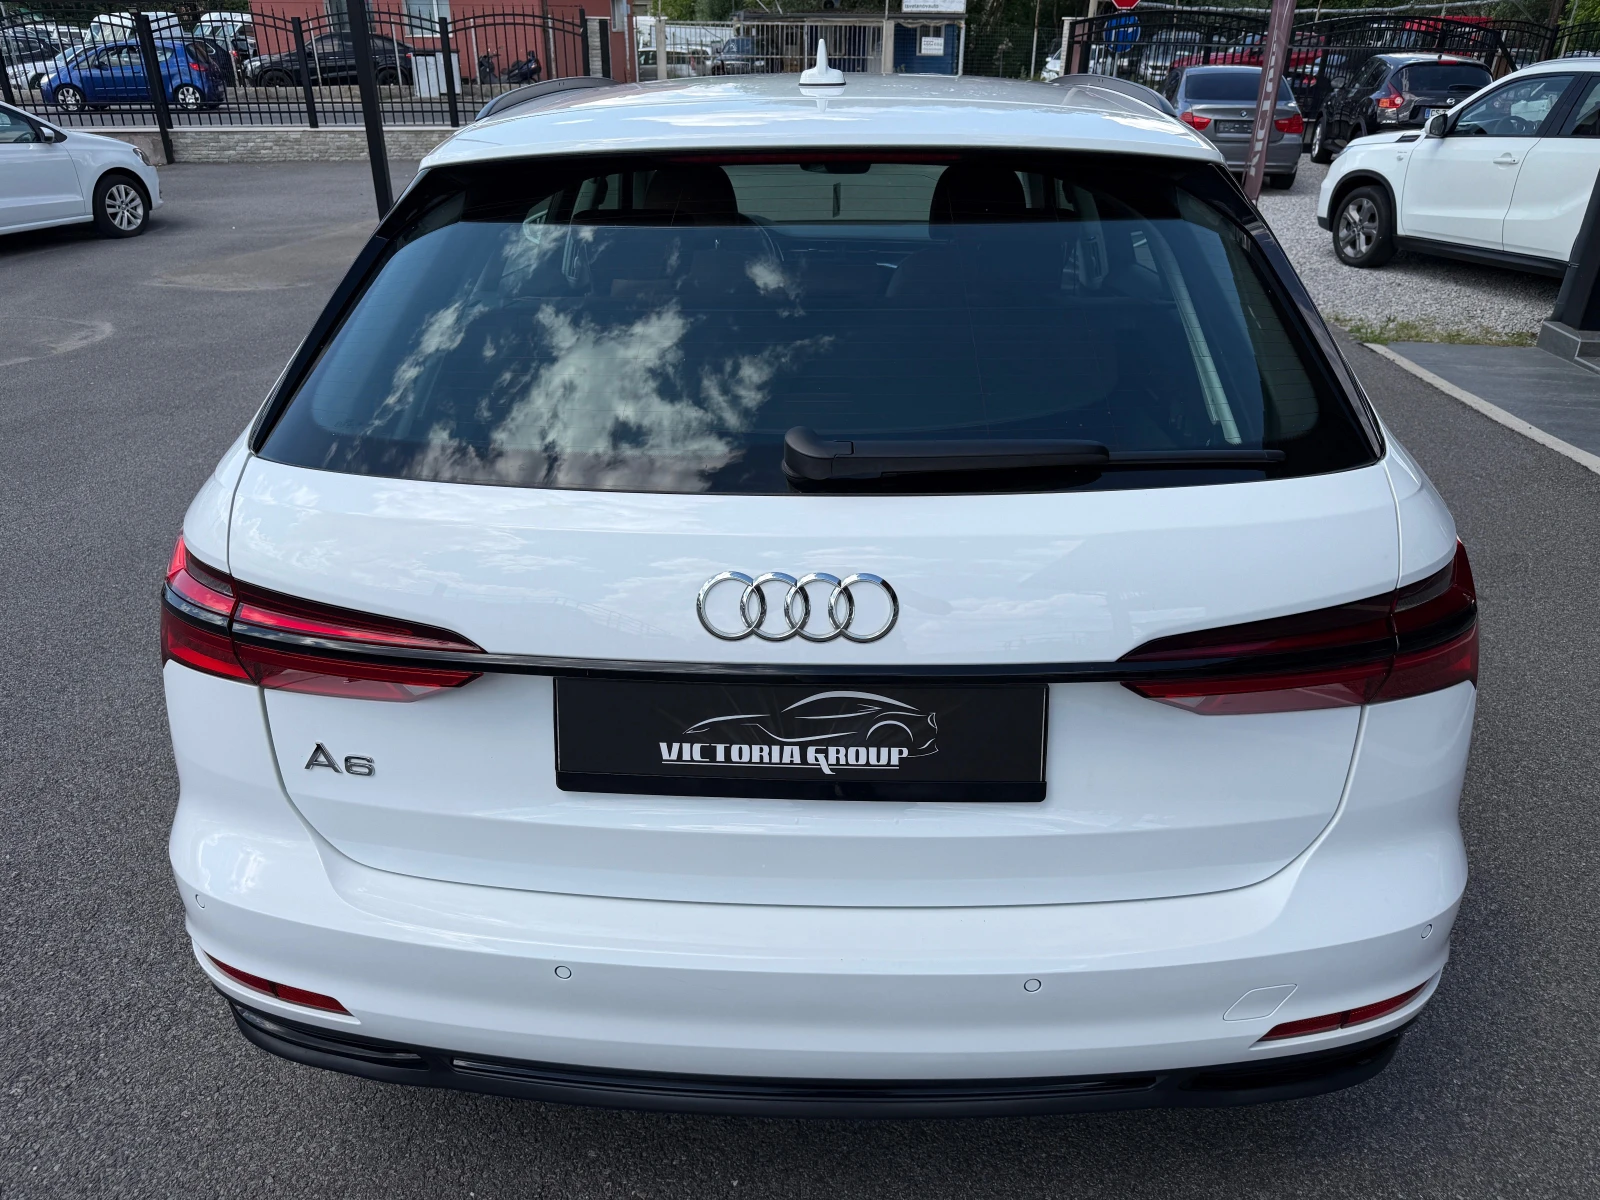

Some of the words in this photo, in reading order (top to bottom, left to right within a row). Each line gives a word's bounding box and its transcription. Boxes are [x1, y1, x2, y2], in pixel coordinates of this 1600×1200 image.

[304, 740, 375, 776] A6
[659, 742, 802, 764] VICTORIA
[806, 745, 909, 775] GROUP
